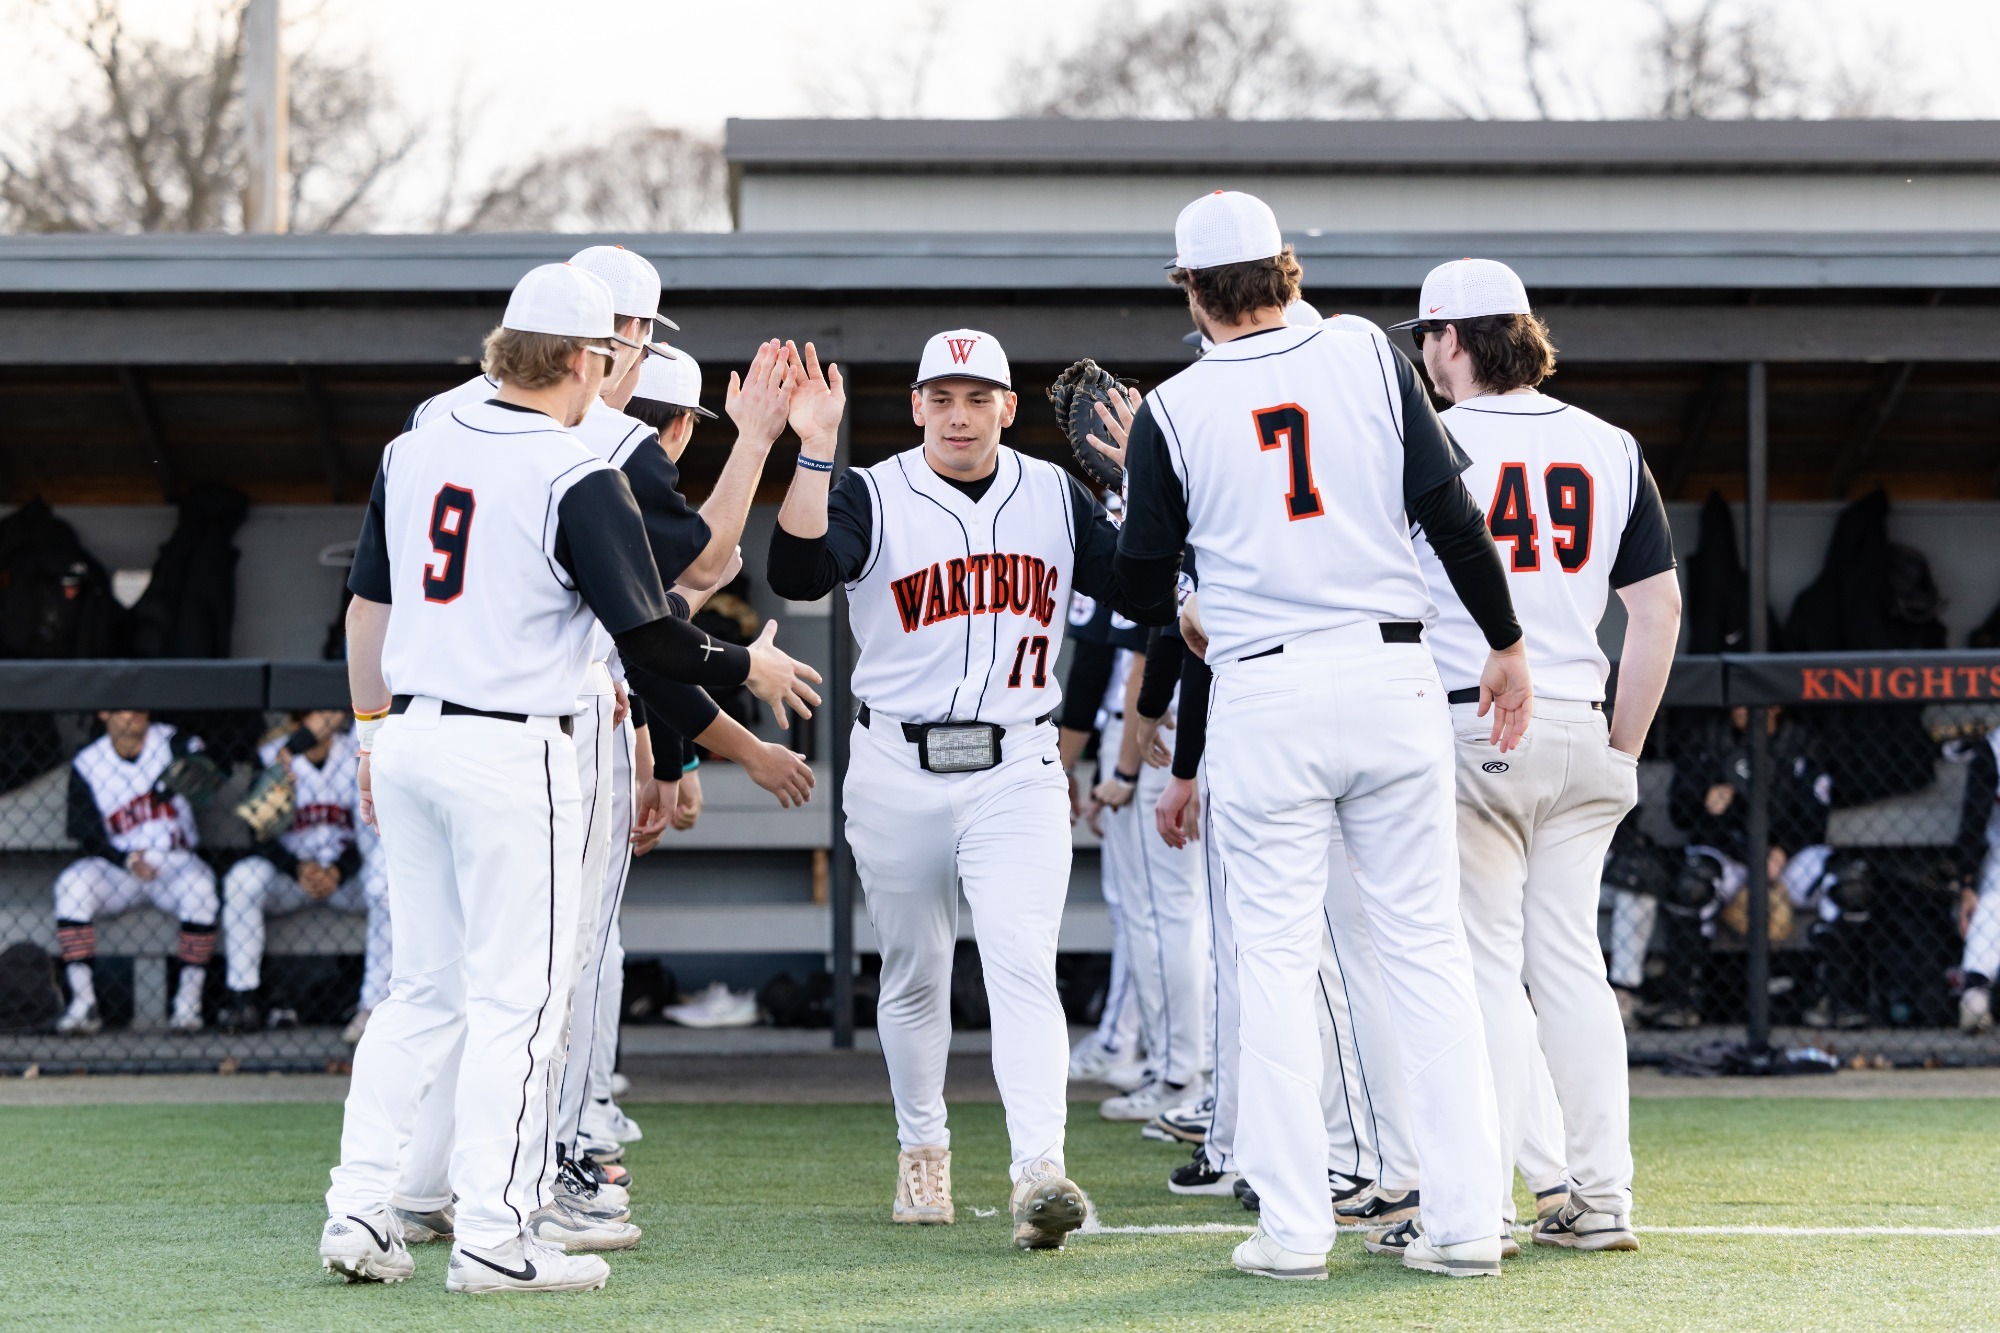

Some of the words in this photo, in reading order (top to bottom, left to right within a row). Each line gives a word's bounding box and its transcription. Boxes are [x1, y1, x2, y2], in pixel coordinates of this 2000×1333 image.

[947, 339, 977, 364] W
[1251, 402, 1325, 522] 7
[422, 482, 476, 604] 9
[1486, 462, 1594, 573] 49
[891, 552, 1058, 633] WARTBURG
[1007, 635, 1049, 688] 17
